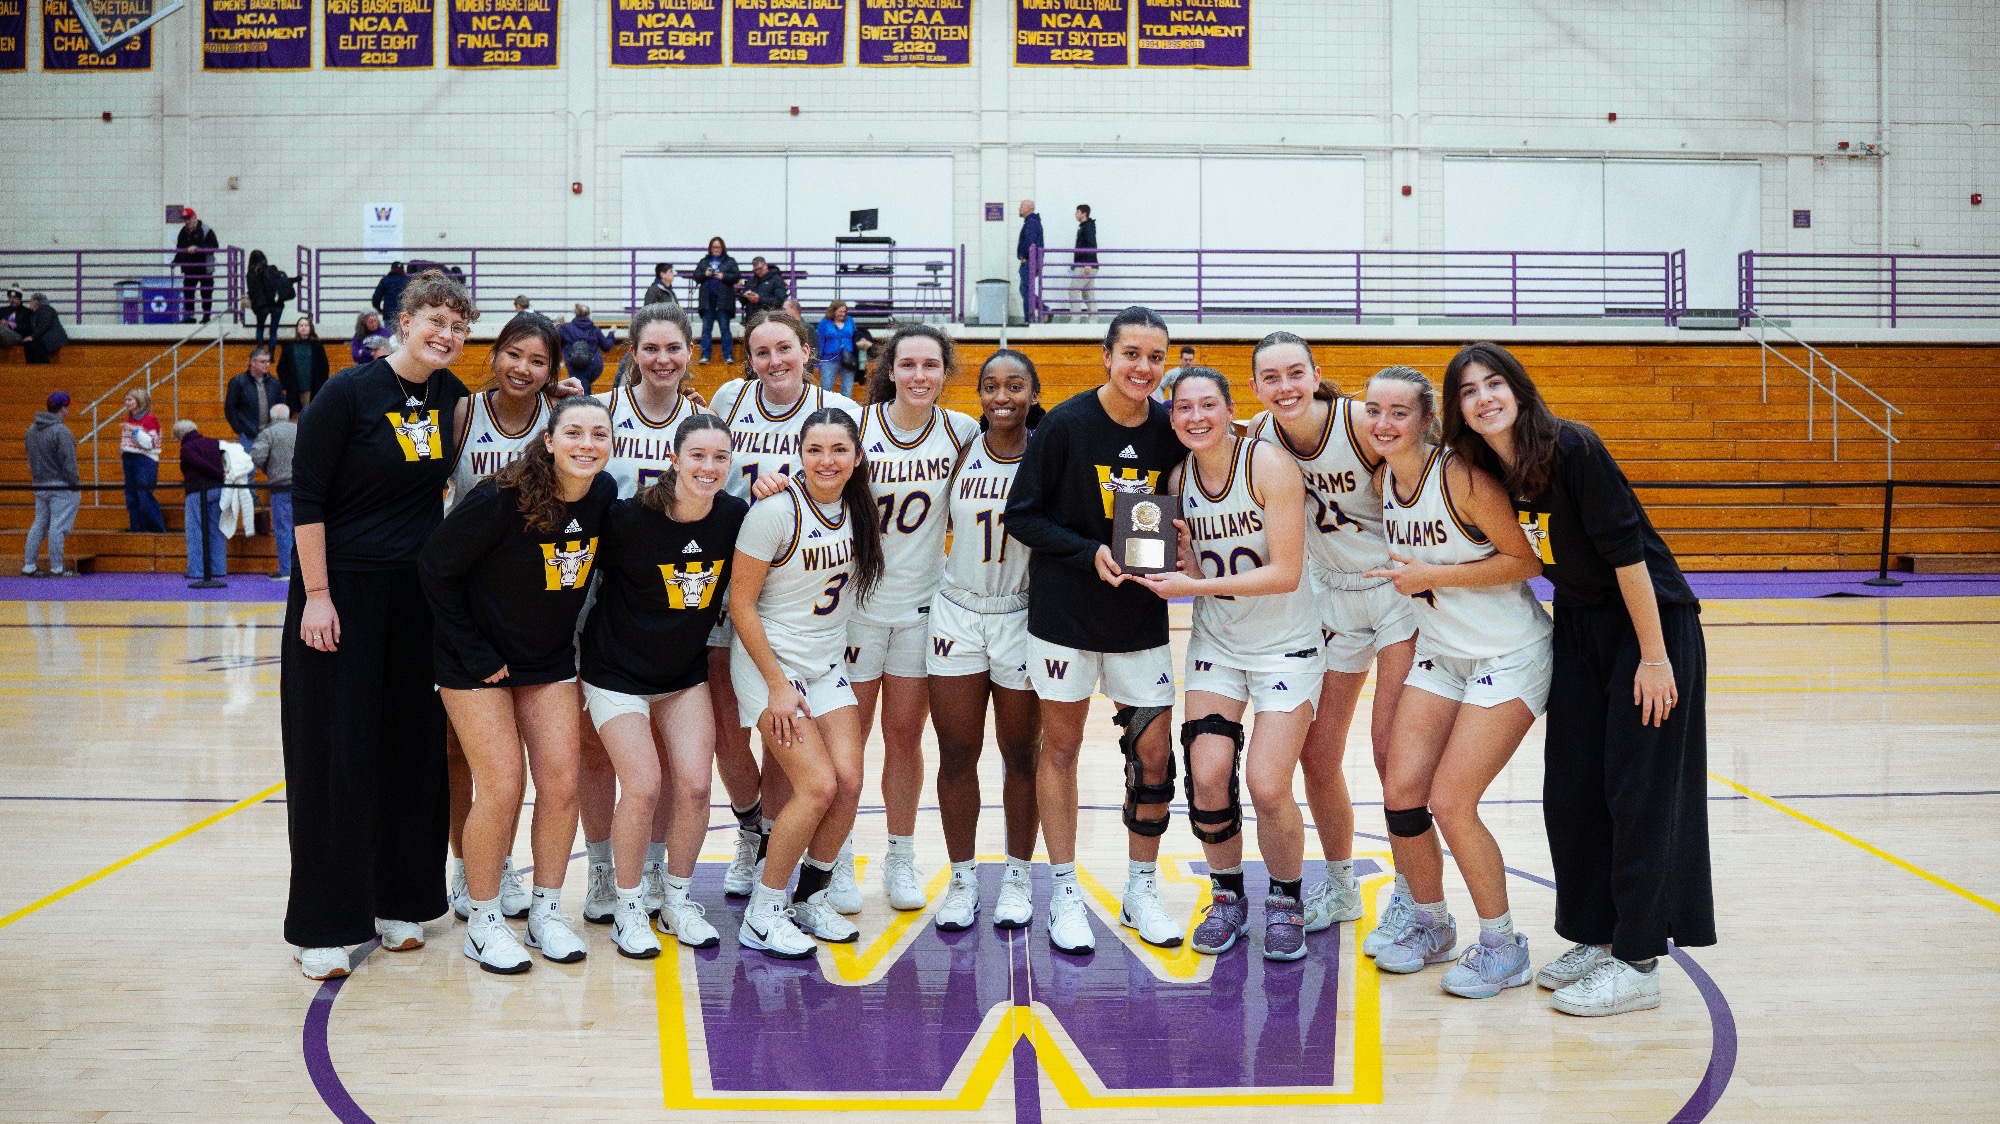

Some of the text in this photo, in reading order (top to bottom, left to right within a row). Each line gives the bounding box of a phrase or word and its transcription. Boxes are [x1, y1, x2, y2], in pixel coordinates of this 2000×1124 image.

[361, 0, 431, 13] BASKETBALL
[495, 0, 551, 12] BASKETBALL
[236, 13, 278, 25] NCAA
[472, 15, 532, 31] NCAA
[637, 13, 695, 28] NCAA
[758, 12, 819, 28] NCAA
[883, 9, 945, 25] NCAA
[1041, 13, 1103, 29] NCAA
[1170, 10, 1217, 22] NCAA
[349, 16, 408, 32] NCAA
[1142, 24, 1245, 37] TOURNAMENT
[209, 27, 307, 40] TOURNAMENT
[619, 31, 714, 46] ELITE EIGHT
[748, 31, 830, 46] ELITE EIGHT
[861, 25, 968, 40] SWEET SIXTEEN
[1017, 30, 1127, 47] SWEET SIXTEEN
[339, 34, 418, 50] ELITE EIGHT
[457, 32, 549, 49] FINAL FOUR
[892, 41, 936, 53] 2020
[361, 52, 398, 64] 2013
[483, 50, 521, 63] 2013
[647, 48, 686, 61] 2014
[768, 48, 808, 61] 2019
[1050, 48, 1094, 61] 2022
[812, 571, 850, 616] 3
[933, 636, 957, 658] W
[1044, 658, 1070, 680] W
